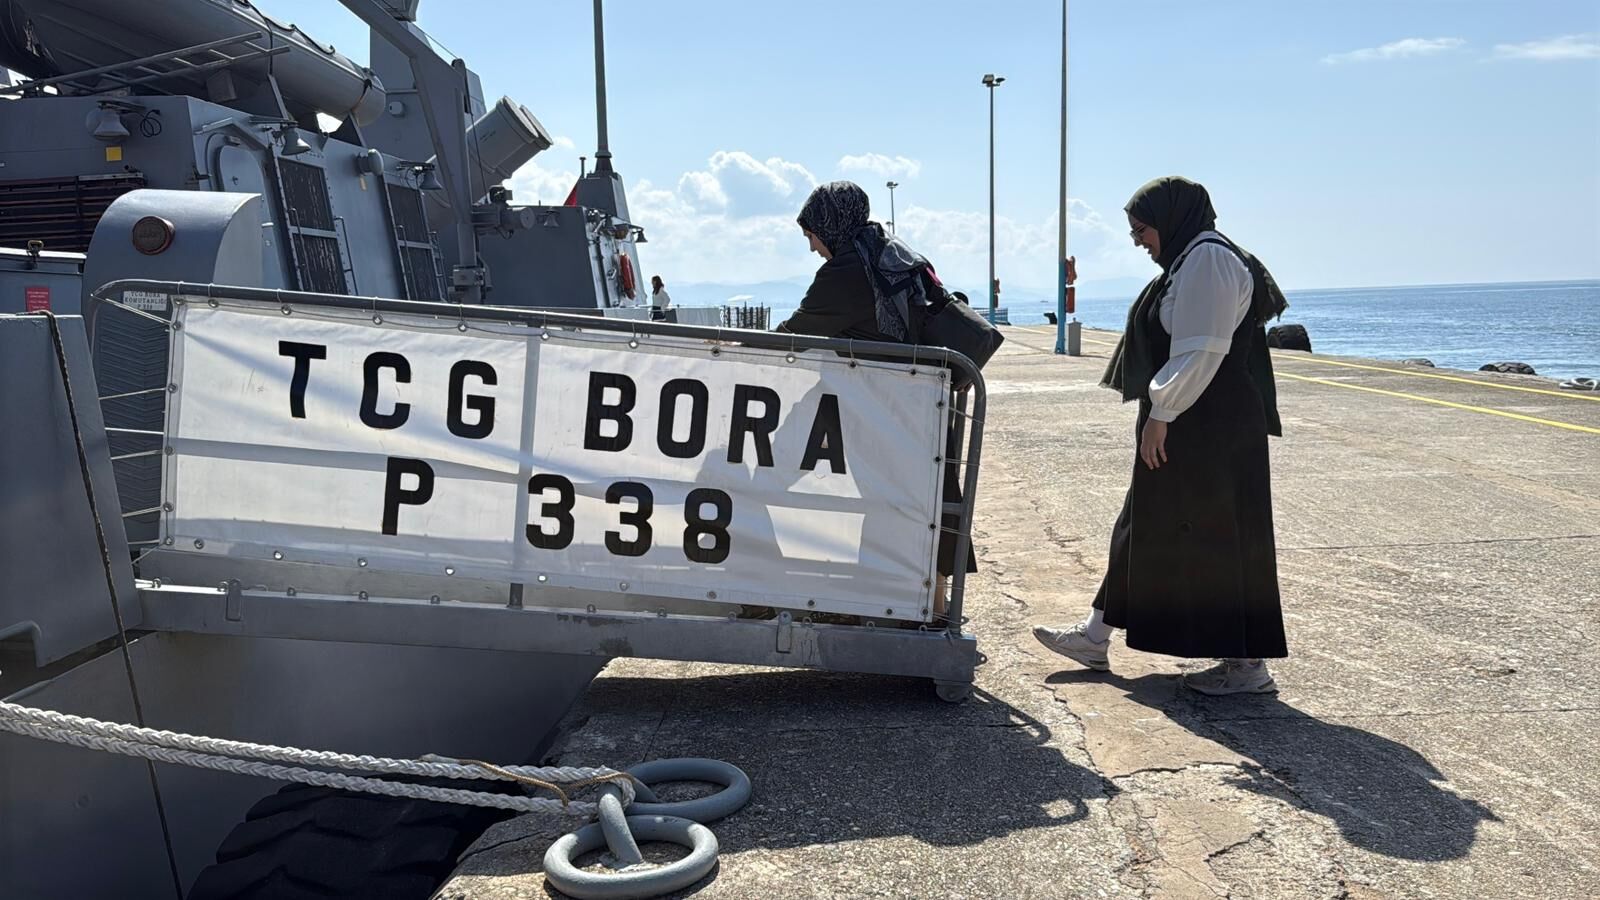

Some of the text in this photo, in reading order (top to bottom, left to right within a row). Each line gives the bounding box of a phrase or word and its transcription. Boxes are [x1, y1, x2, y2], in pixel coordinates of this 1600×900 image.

[279, 341, 847, 474] TCG BORA
[382, 457, 732, 564] P 338
